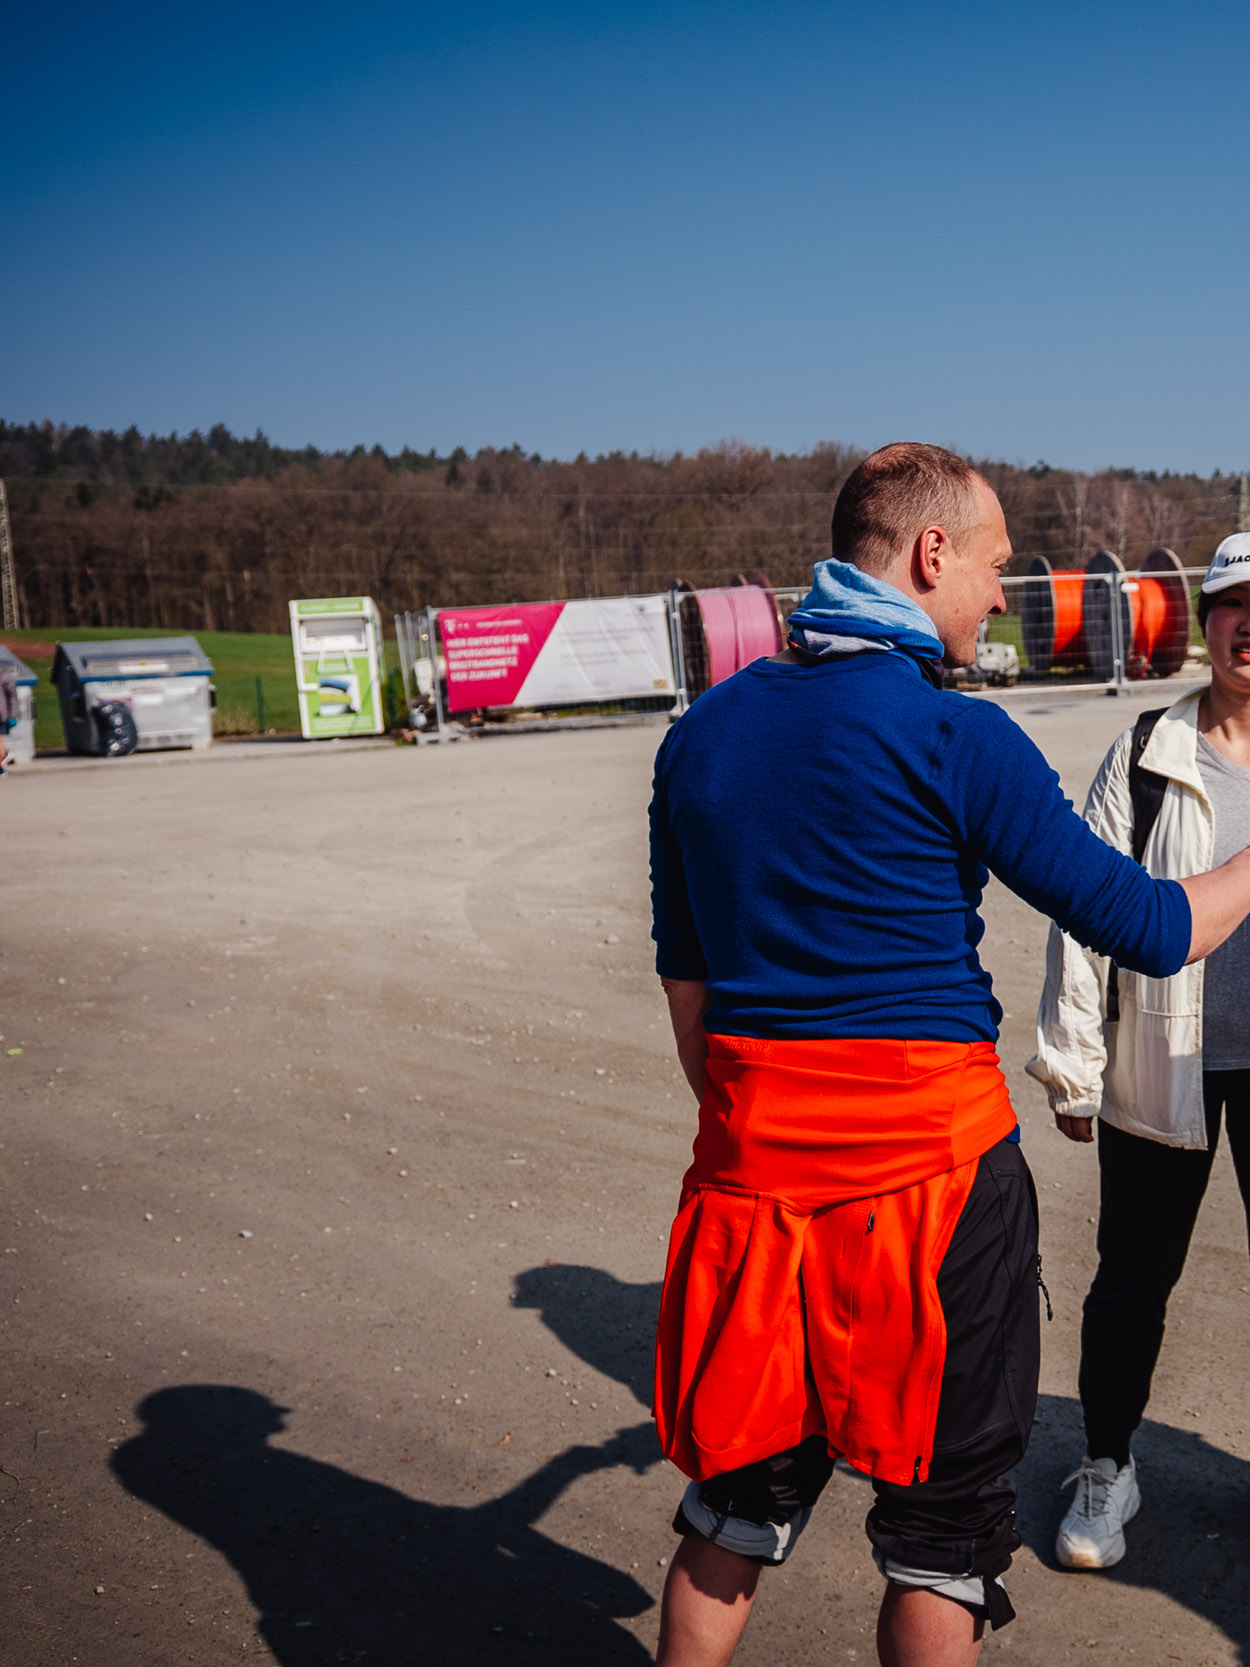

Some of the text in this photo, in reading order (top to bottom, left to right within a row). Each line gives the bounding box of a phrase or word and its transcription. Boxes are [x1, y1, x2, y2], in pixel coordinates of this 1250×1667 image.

[447, 633, 528, 648] HIER ENTSTEHT DAS
[448, 646, 518, 659] SUPERSCHNELLE
[449, 657, 518, 670] BREITBANDNETZ
[450, 668, 507, 682] DER ZUKUNFT
